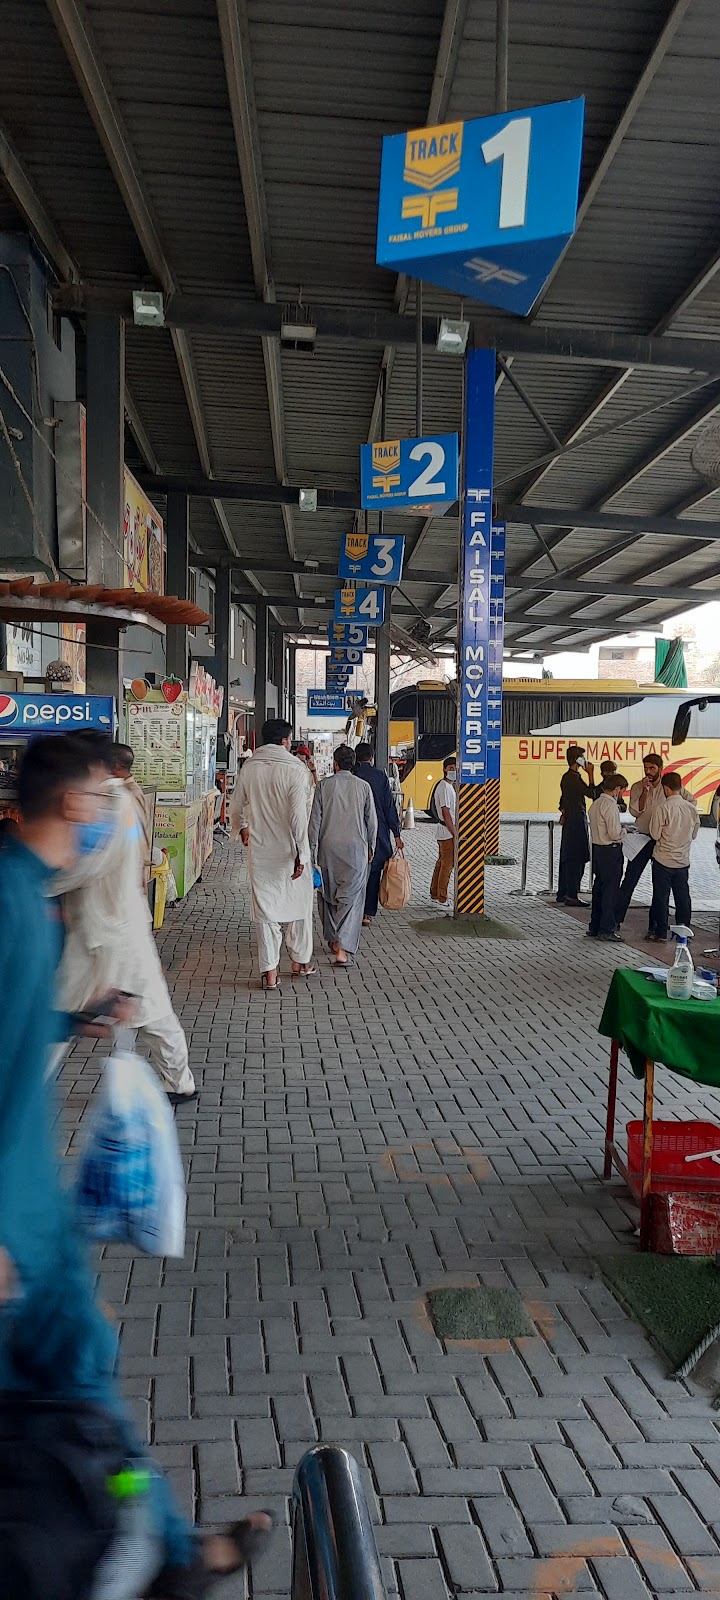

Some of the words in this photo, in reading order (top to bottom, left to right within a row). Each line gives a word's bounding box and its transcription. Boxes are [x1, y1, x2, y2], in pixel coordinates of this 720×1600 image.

[409, 131, 459, 161] TRACK
[480, 116, 533, 230] 1
[388, 232, 412, 243] FAISAL
[413, 227, 443, 240] MOVERS
[443, 223, 469, 235] GROUP
[373, 445, 399, 459] TRACK
[408, 441, 446, 498] 2
[347, 537, 367, 548] TRACK
[370, 538, 396, 576] 3
[468, 511, 486, 623] FAISAL
[358, 590, 380, 619] 4
[348, 624, 364, 644] 5
[346, 648, 360, 663] 6
[464, 646, 485, 754] MOVERS
[22, 702, 91, 725] pepsi
[587, 741, 670, 761] MAKHTAR
